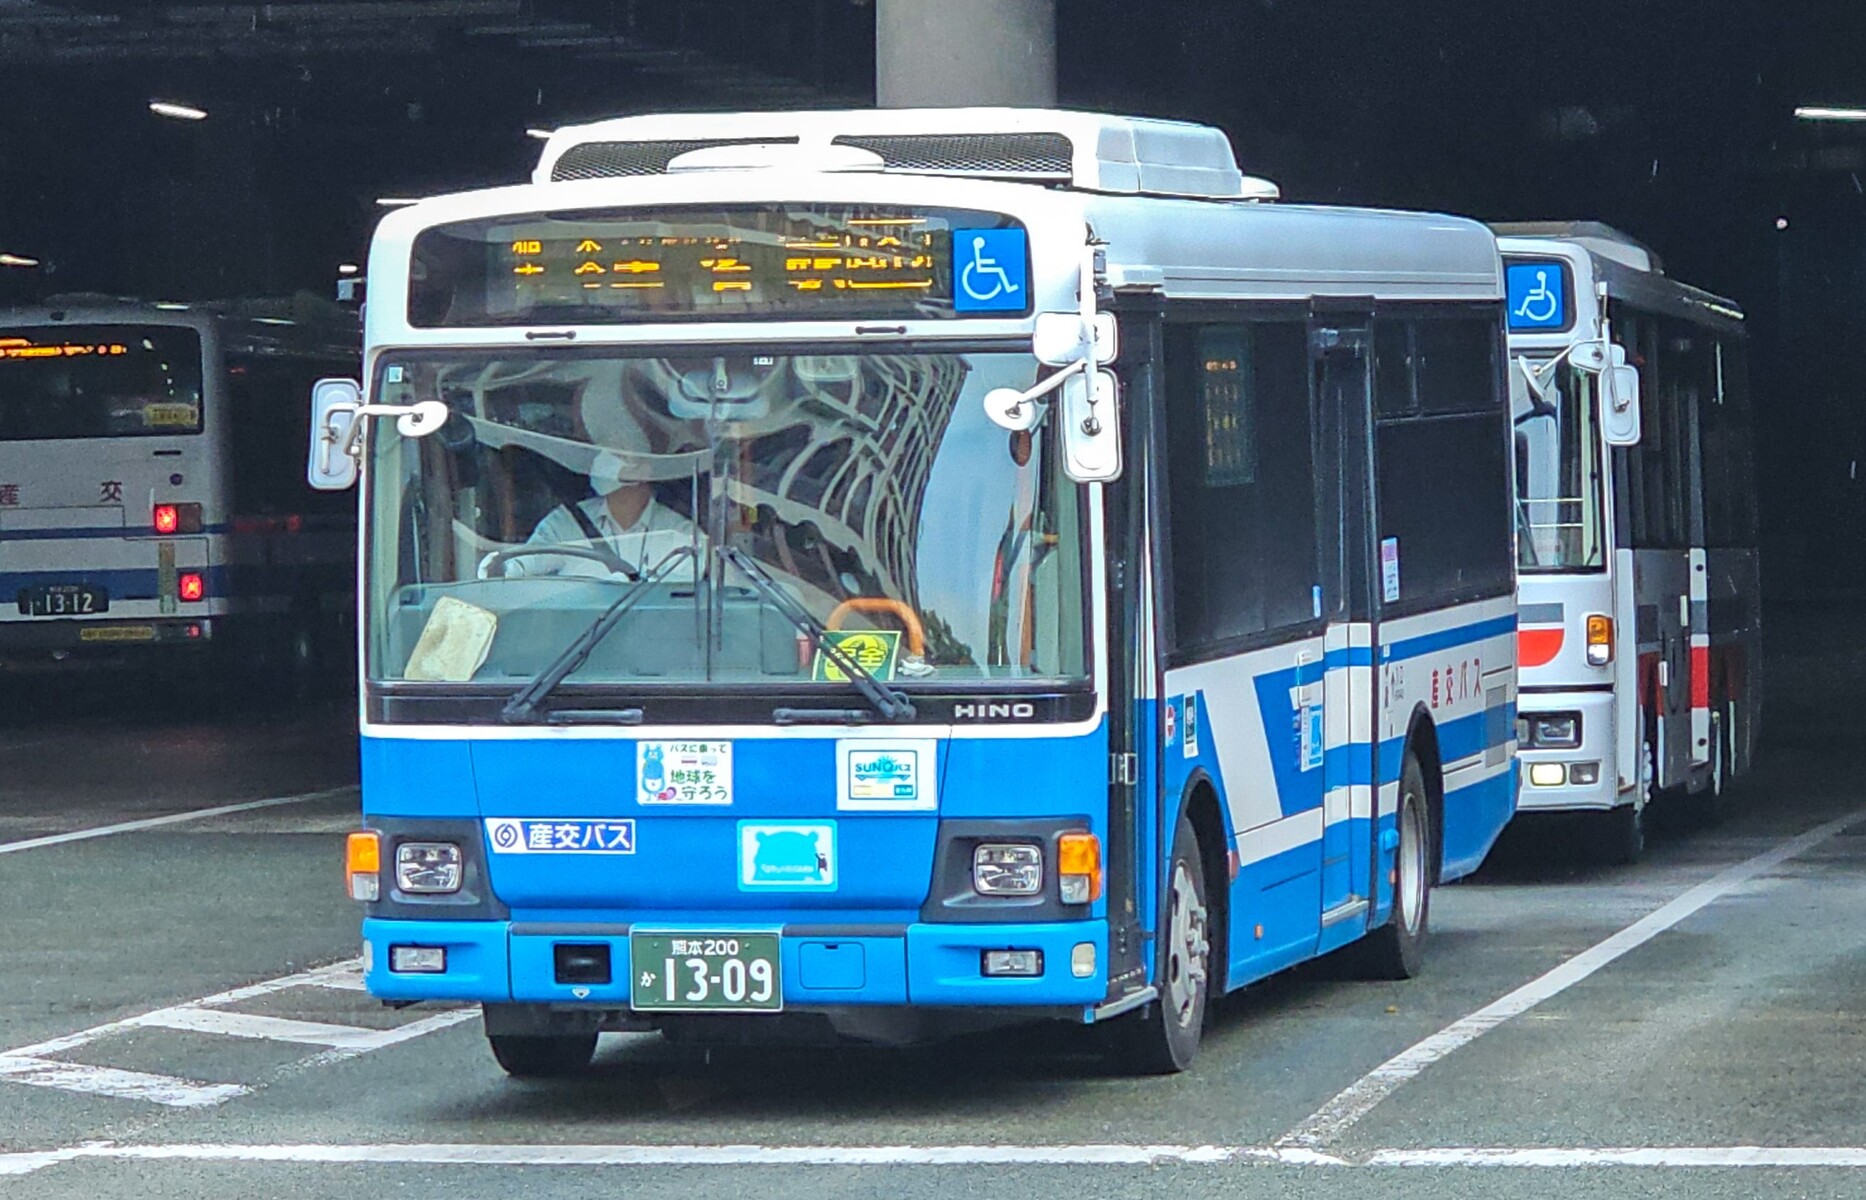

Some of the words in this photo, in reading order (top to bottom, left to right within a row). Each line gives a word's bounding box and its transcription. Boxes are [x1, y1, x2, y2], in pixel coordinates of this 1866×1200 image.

[955, 703, 1034, 718] HINO
[670, 769, 717, 784] 地球を
[681, 785, 728, 801] 守ろう
[528, 823, 632, 849] 産交バス
[671, 939, 739, 956] 熊本200
[640, 971, 657, 987] か
[664, 957, 773, 1002] 13-09
